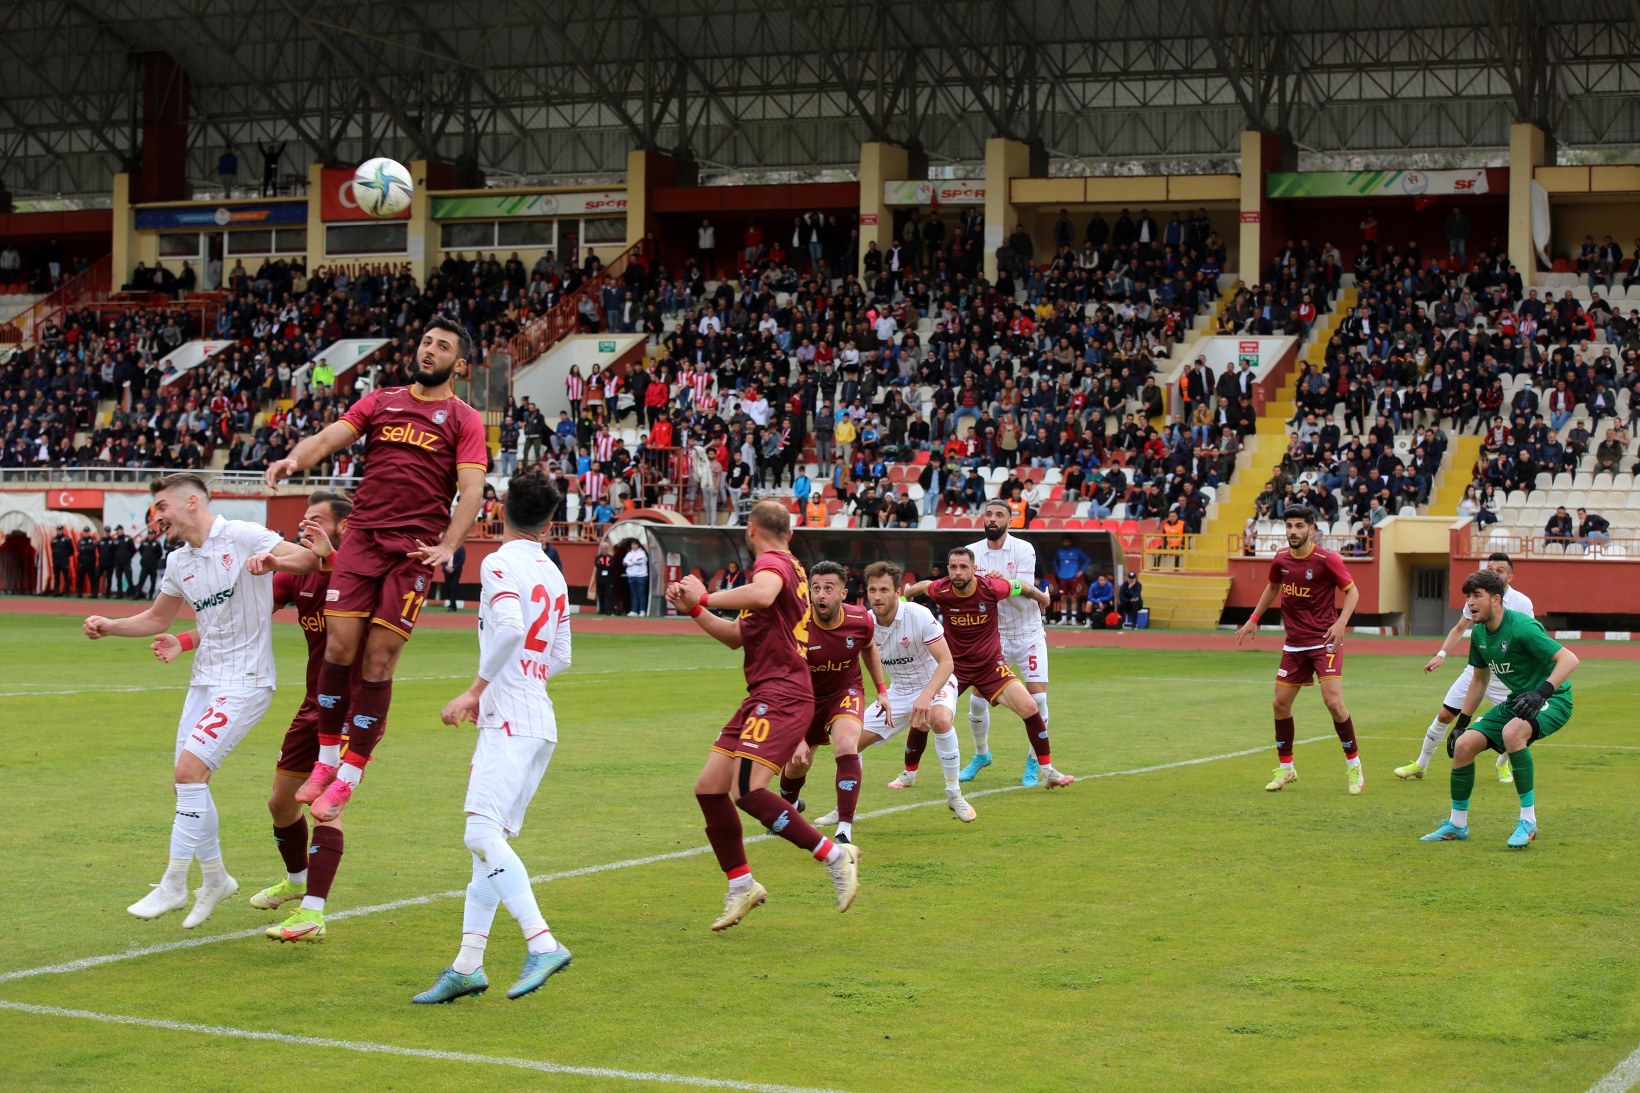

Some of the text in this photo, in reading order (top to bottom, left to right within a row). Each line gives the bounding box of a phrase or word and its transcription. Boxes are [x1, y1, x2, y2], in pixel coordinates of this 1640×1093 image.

[941, 188, 986, 199] SPOR
[584, 198, 627, 210] SPOR
[380, 422, 438, 452] seluz
[1281, 582, 1311, 598] seluz
[401, 590, 424, 622] 11
[523, 583, 566, 657] 21
[950, 613, 988, 627] seluz
[1028, 655, 1038, 672] 5
[1325, 653, 1336, 669] 7
[1487, 659, 1514, 675] eluz
[839, 695, 861, 712] 41
[194, 706, 229, 740] 22
[739, 716, 771, 743] 20
